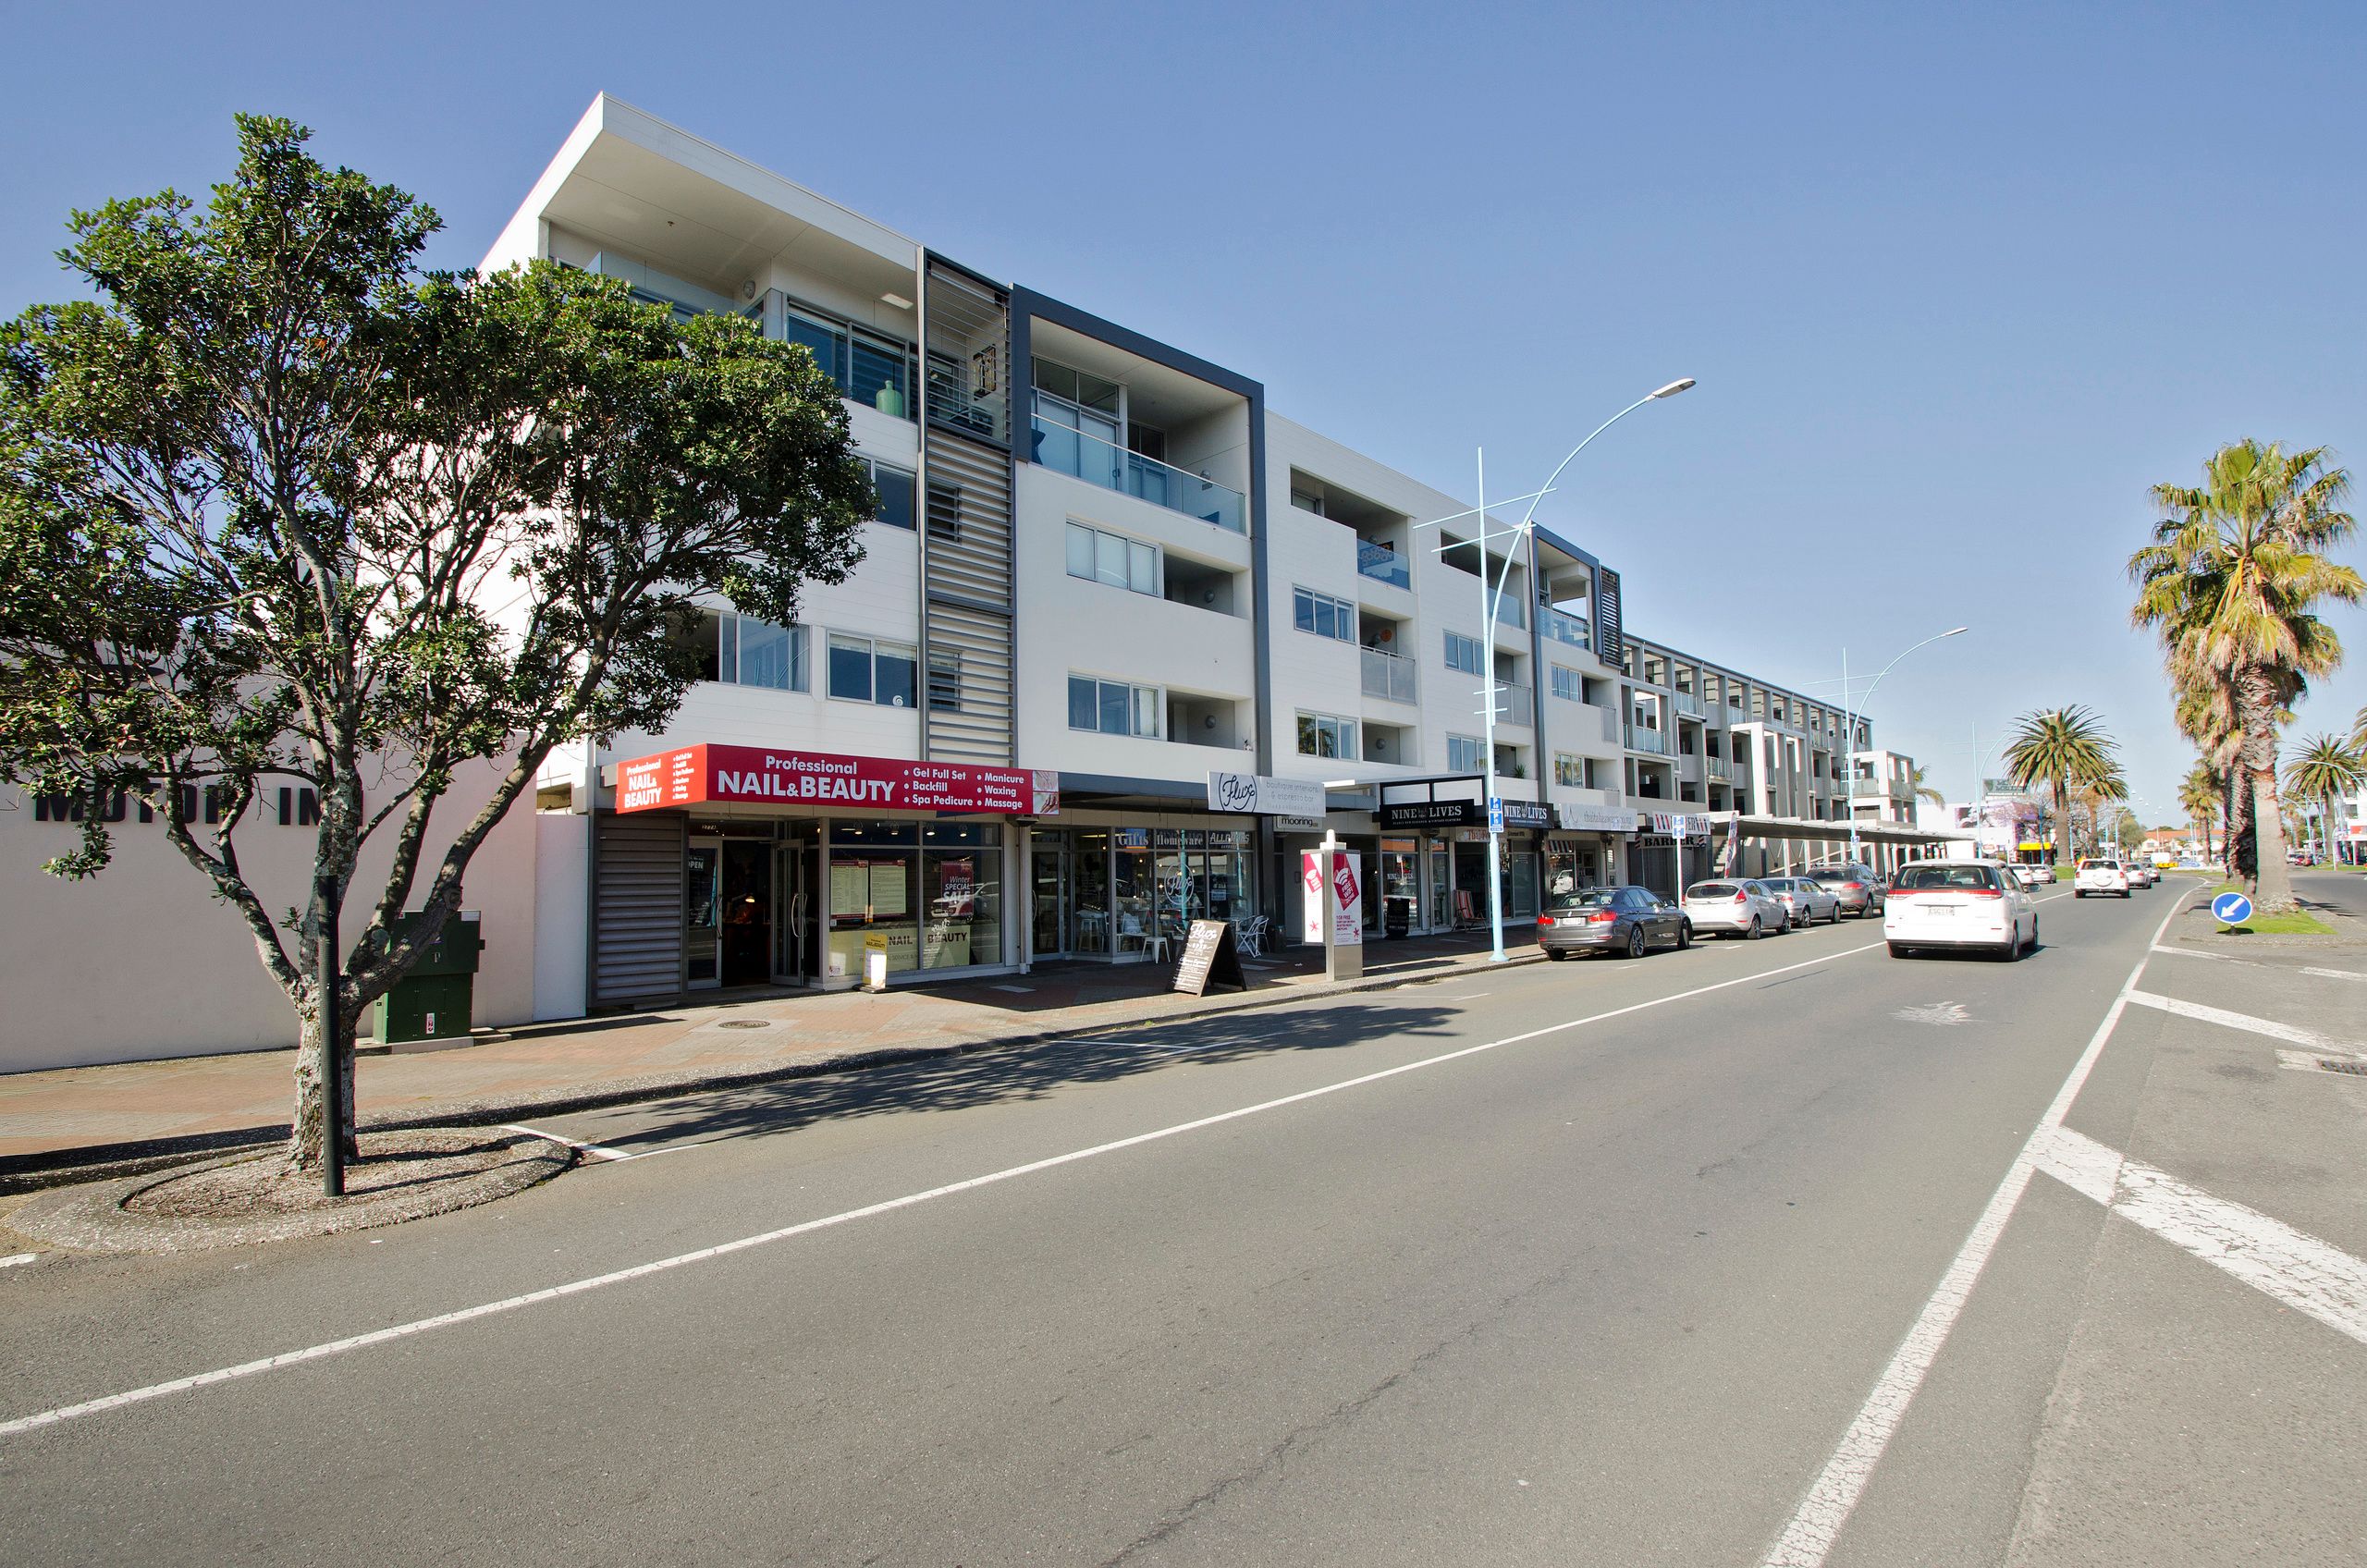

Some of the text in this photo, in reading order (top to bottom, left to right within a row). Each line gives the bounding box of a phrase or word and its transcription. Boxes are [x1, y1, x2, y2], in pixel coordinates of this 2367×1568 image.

[626, 758, 661, 777] Professional
[766, 754, 857, 775] Professional
[913, 767, 966, 780] Gel Full Set
[985, 773, 1024, 784] Manicure
[913, 781, 948, 791] Backfill
[984, 786, 1017, 797] Waxing
[624, 787, 663, 809] BEAUTY
[912, 794, 973, 806] Spa Pedicure
[984, 799, 1023, 810] Massage
[279, 787, 363, 826] IN
[1391, 805, 1462, 820] NINE LIVES
[1503, 805, 1547, 819] NINE LIVES
[1281, 816, 1313, 827] mooring
[1118, 832, 1148, 846] Gifts
[943, 890, 971, 902] SALE
[889, 932, 967, 946] NAIL BEAUTY
